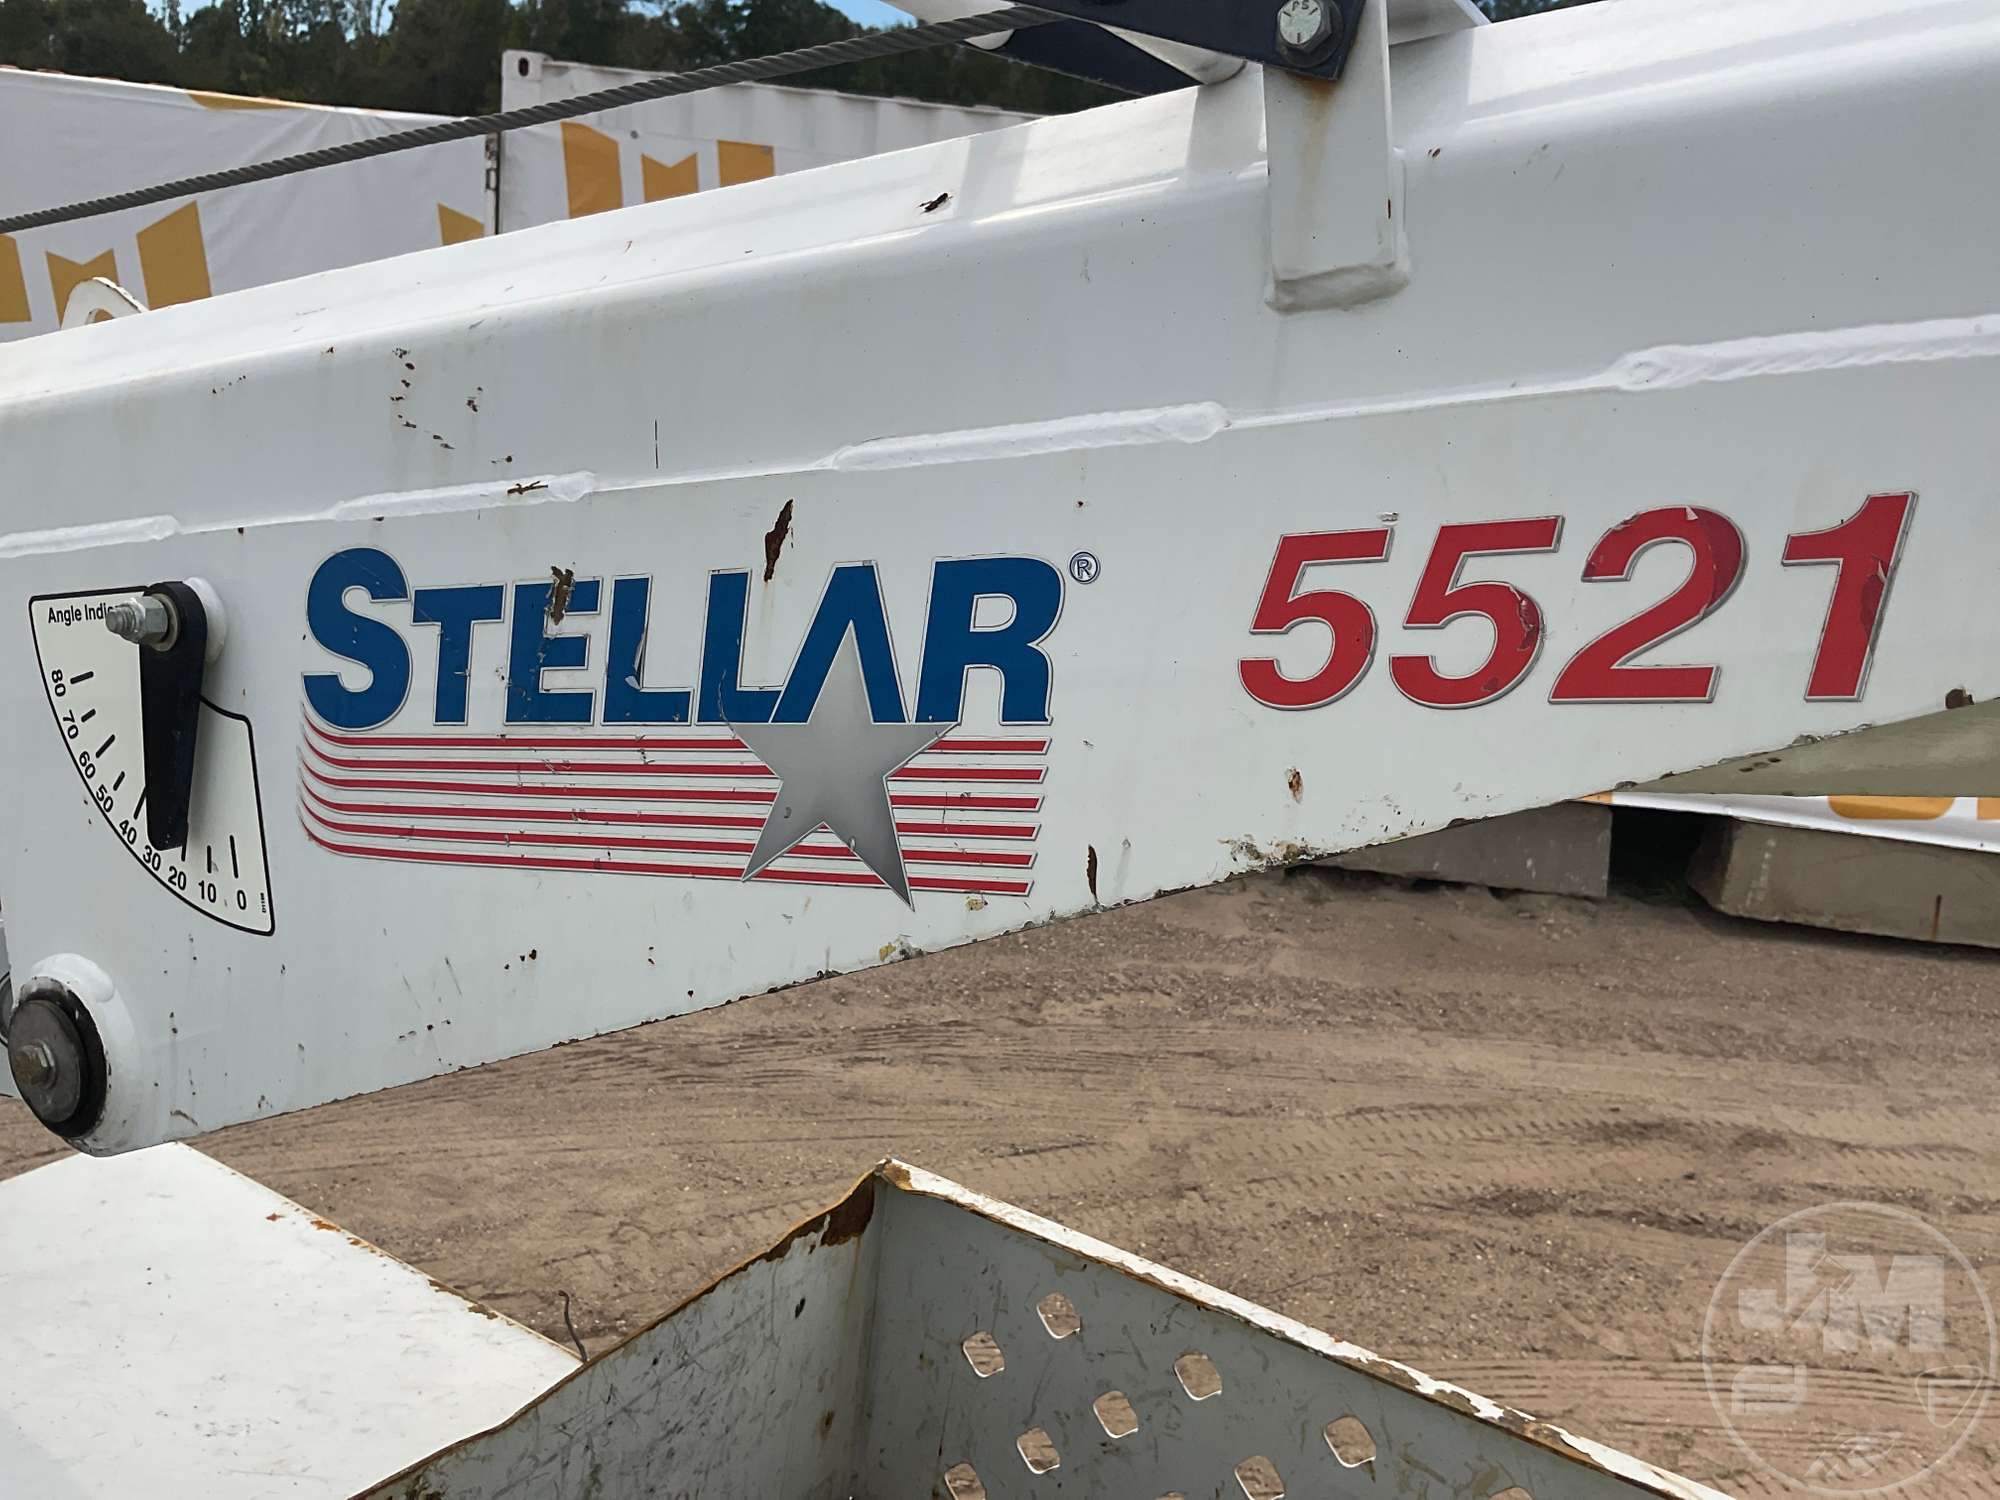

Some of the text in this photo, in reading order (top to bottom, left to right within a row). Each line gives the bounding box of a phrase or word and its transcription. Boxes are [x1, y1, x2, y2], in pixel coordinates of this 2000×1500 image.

[1237, 490, 1919, 711] 5521
[48, 605, 82, 626] Angle
[302, 546, 1066, 731] STELLAR
[51, 669, 66, 697] 80
[62, 709, 79, 740] 70
[79, 751, 96, 779] 60
[96, 784, 114, 813] 50
[119, 820, 137, 845] 40
[142, 845, 161, 871] 30
[167, 866, 187, 891] 20
[198, 880, 216, 903] 10
[236, 889, 247, 910] 0
